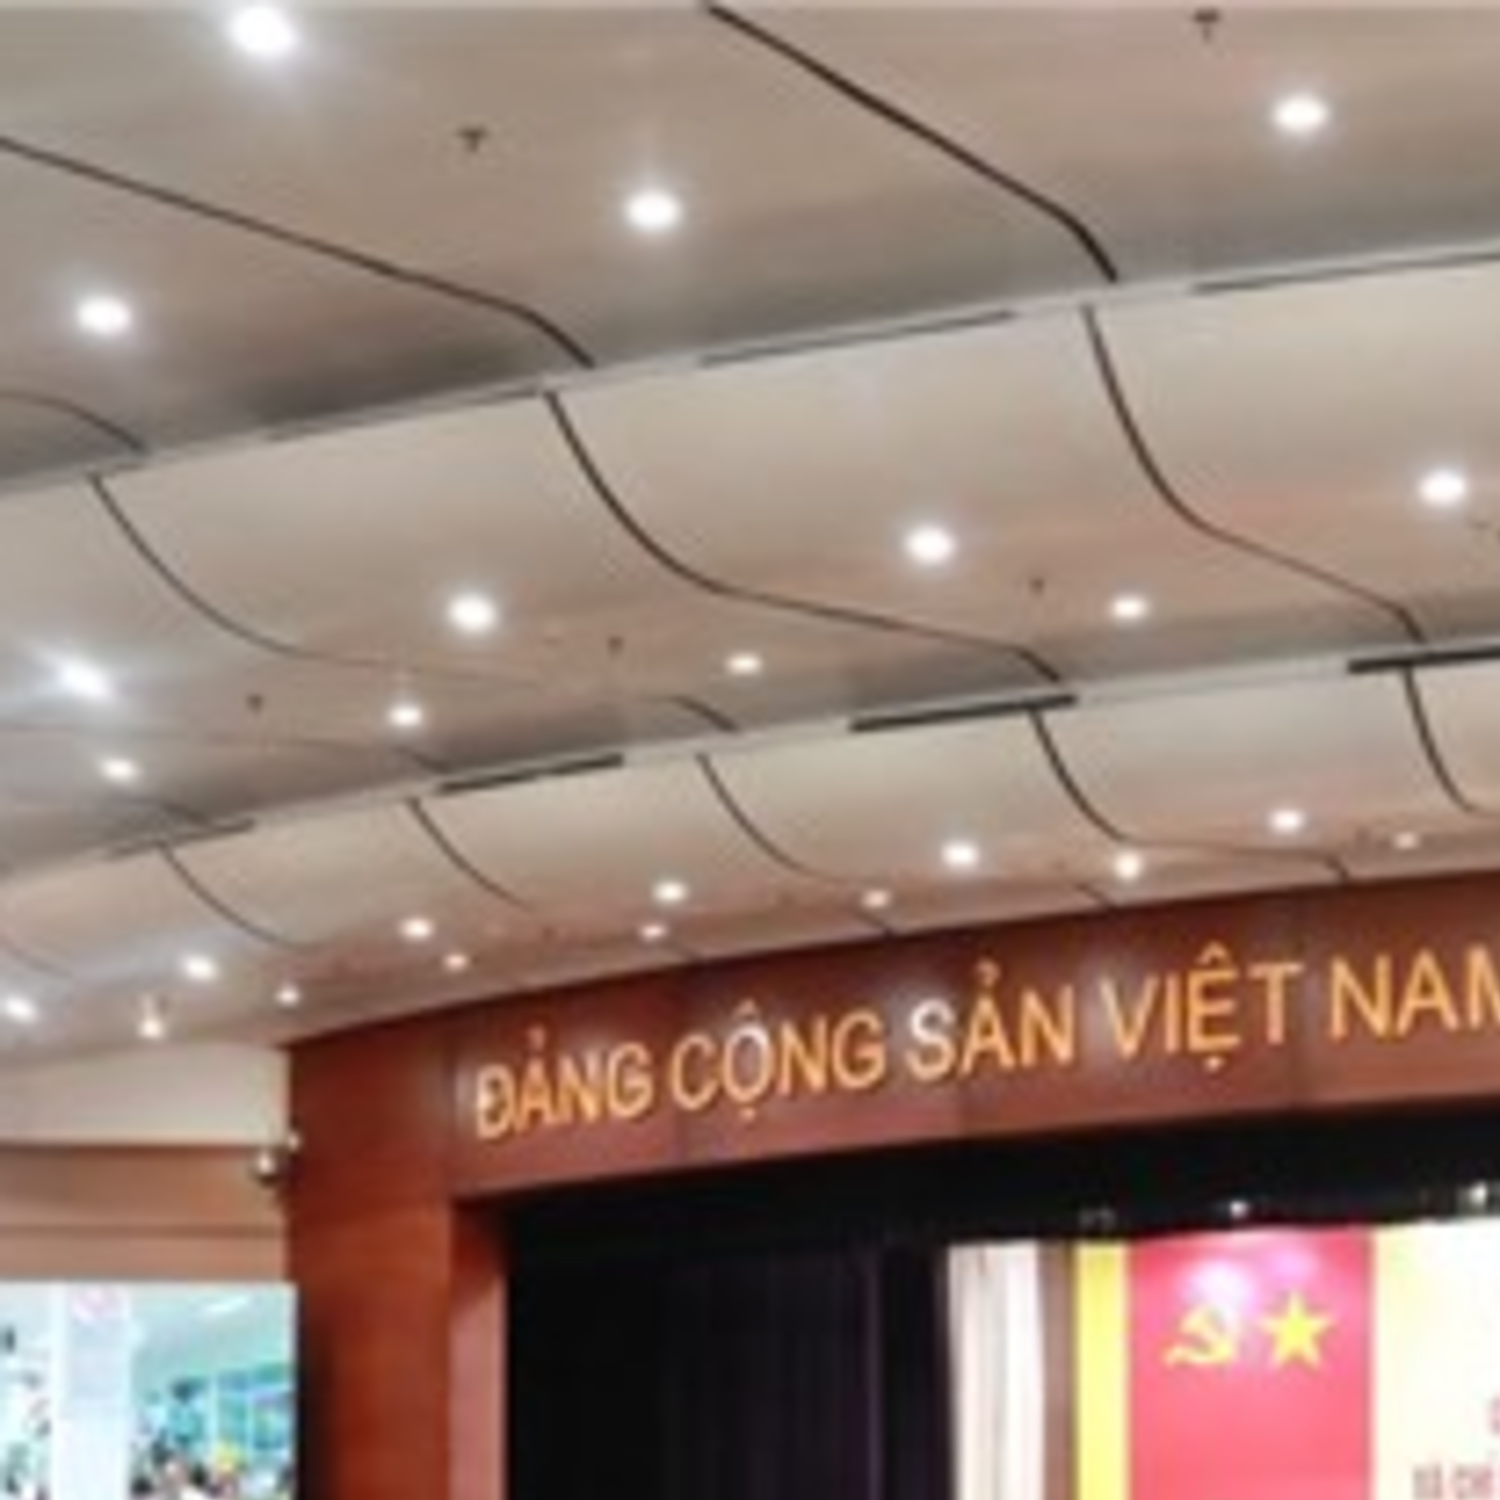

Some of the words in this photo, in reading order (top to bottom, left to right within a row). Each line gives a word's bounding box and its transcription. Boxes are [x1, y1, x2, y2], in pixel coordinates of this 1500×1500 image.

[474, 1026, 653, 1139] ĐẢNG
[669, 1002, 885, 1121] CỘNG
[905, 959, 1076, 1084] SẢN
[1102, 941, 1301, 1075] VIỆT
